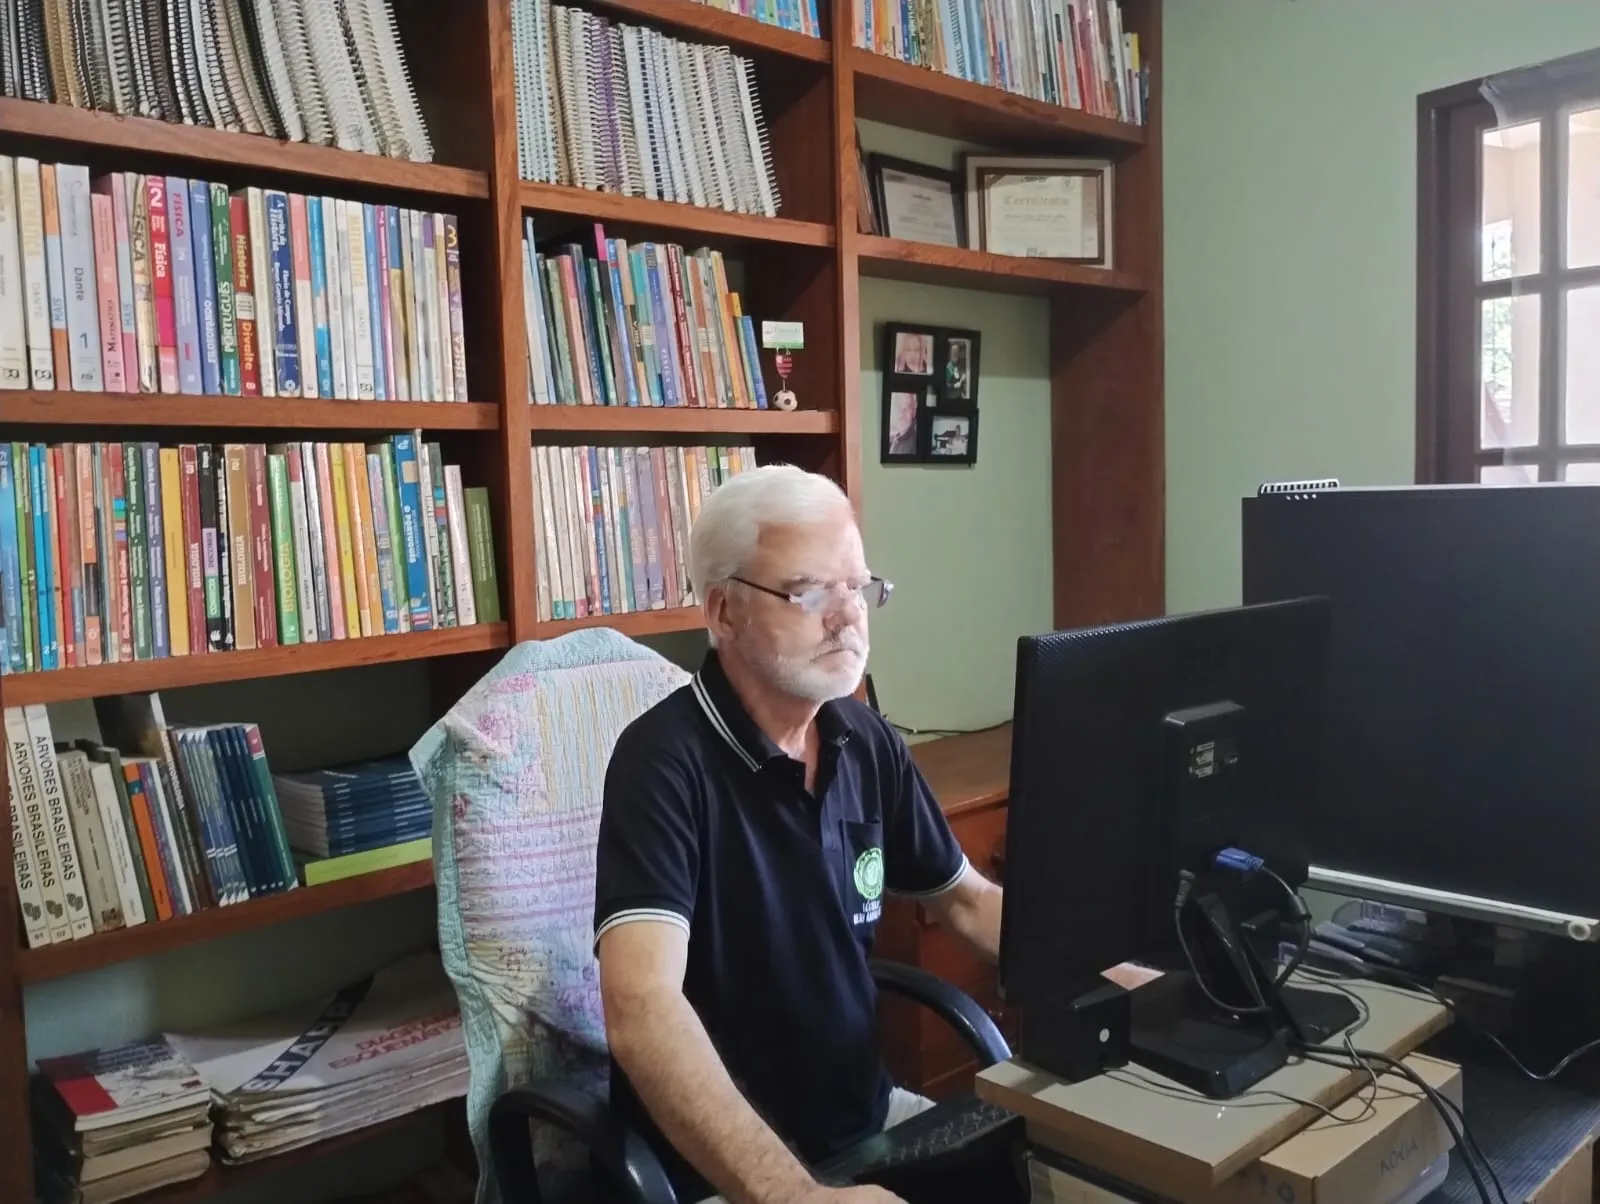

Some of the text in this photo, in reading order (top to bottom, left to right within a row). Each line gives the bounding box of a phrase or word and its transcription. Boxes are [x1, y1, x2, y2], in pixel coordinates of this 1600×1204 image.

[149, 189, 164, 208] 2
[173, 192, 186, 238] FÍSICA
[73, 266, 84, 302] Dante
[154, 242, 168, 278] Física
[219, 281, 235, 352] PORTUGUÊS
[235, 234, 254, 371] História Divalte
[190, 542, 202, 589] BIOLOGIA
[236, 535, 249, 585] BIOLOGIA
[280, 543, 295, 613] BIOLOGIA
[14, 741, 56, 888] ÁRVORES BRASILEIRAS
[35, 735, 76, 881] ÁRVORES BRASILEIRAS
